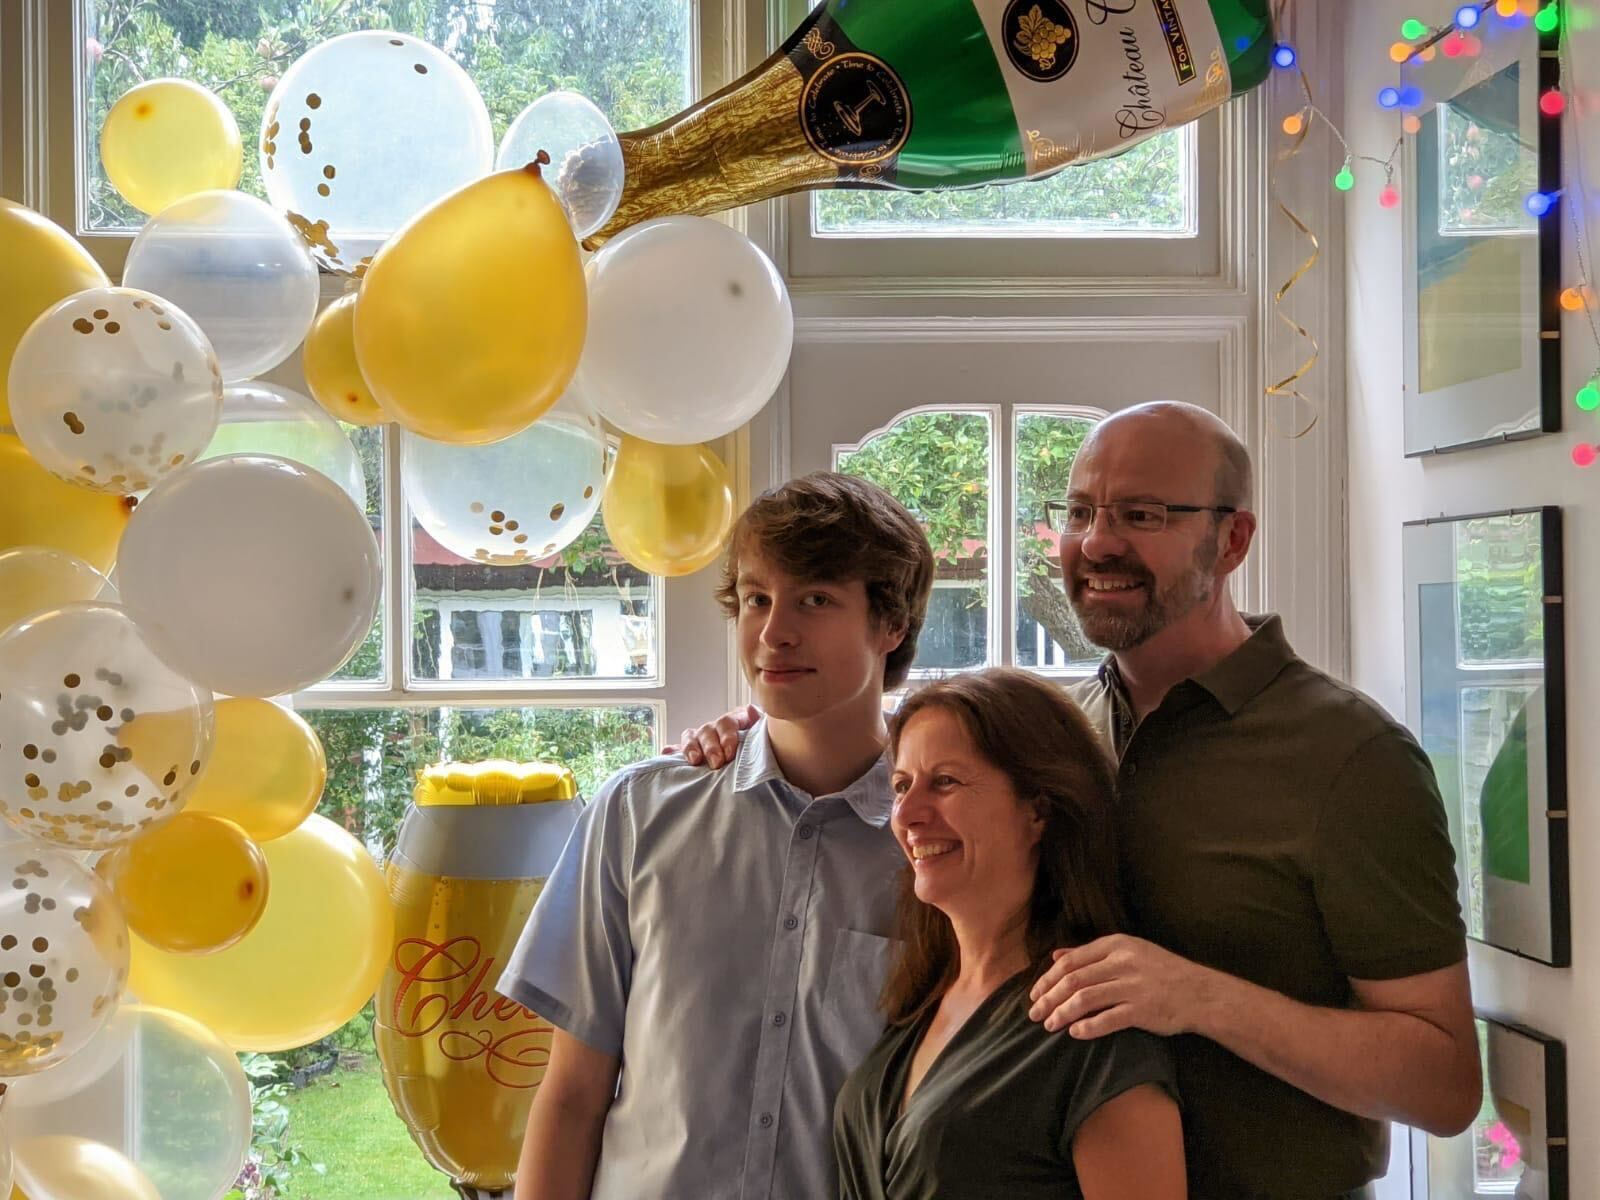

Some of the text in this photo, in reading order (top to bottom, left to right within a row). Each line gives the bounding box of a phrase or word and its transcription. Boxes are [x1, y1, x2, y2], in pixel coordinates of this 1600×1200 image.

[1162, 0, 1190, 71] FOR VINTA
[1115, 26, 1165, 139] Château
